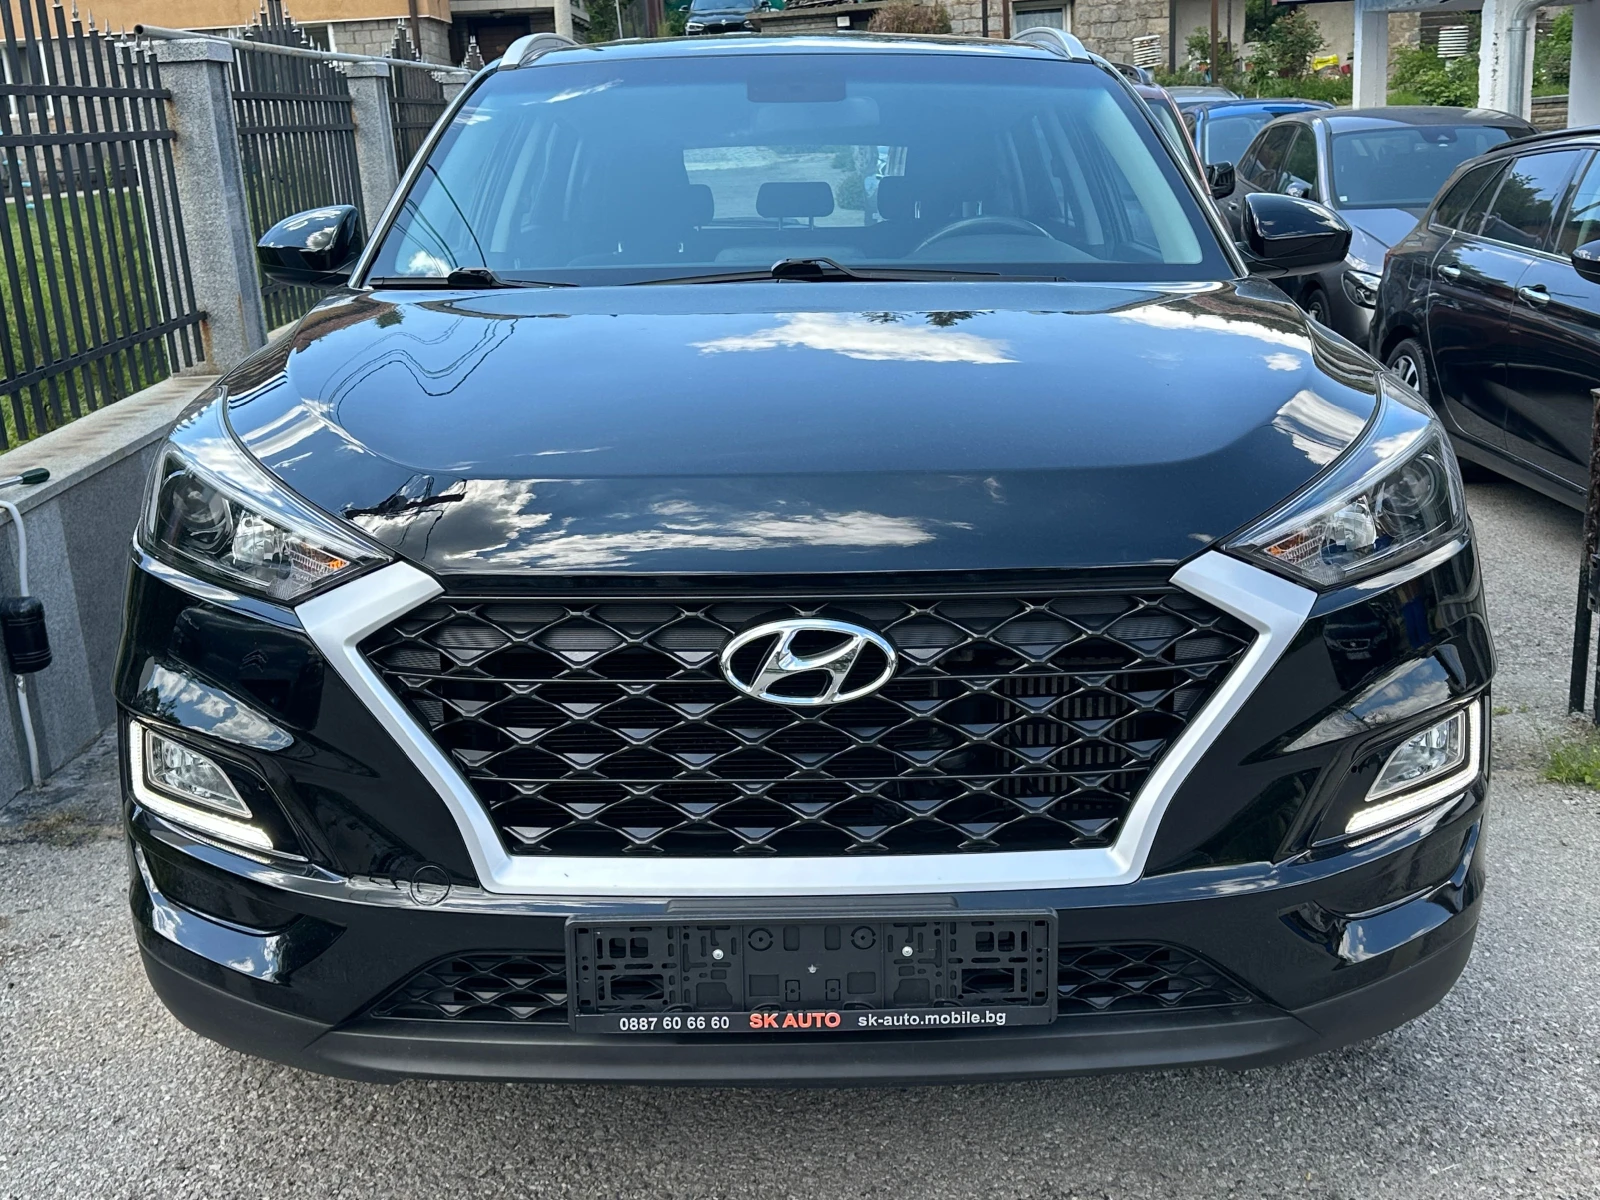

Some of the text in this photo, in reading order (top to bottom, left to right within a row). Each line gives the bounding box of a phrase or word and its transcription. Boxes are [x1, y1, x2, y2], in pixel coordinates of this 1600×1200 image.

[619, 1010, 1007, 1031] 0887 60 66 60 SK AUTO sk-auto.mobile.bg
